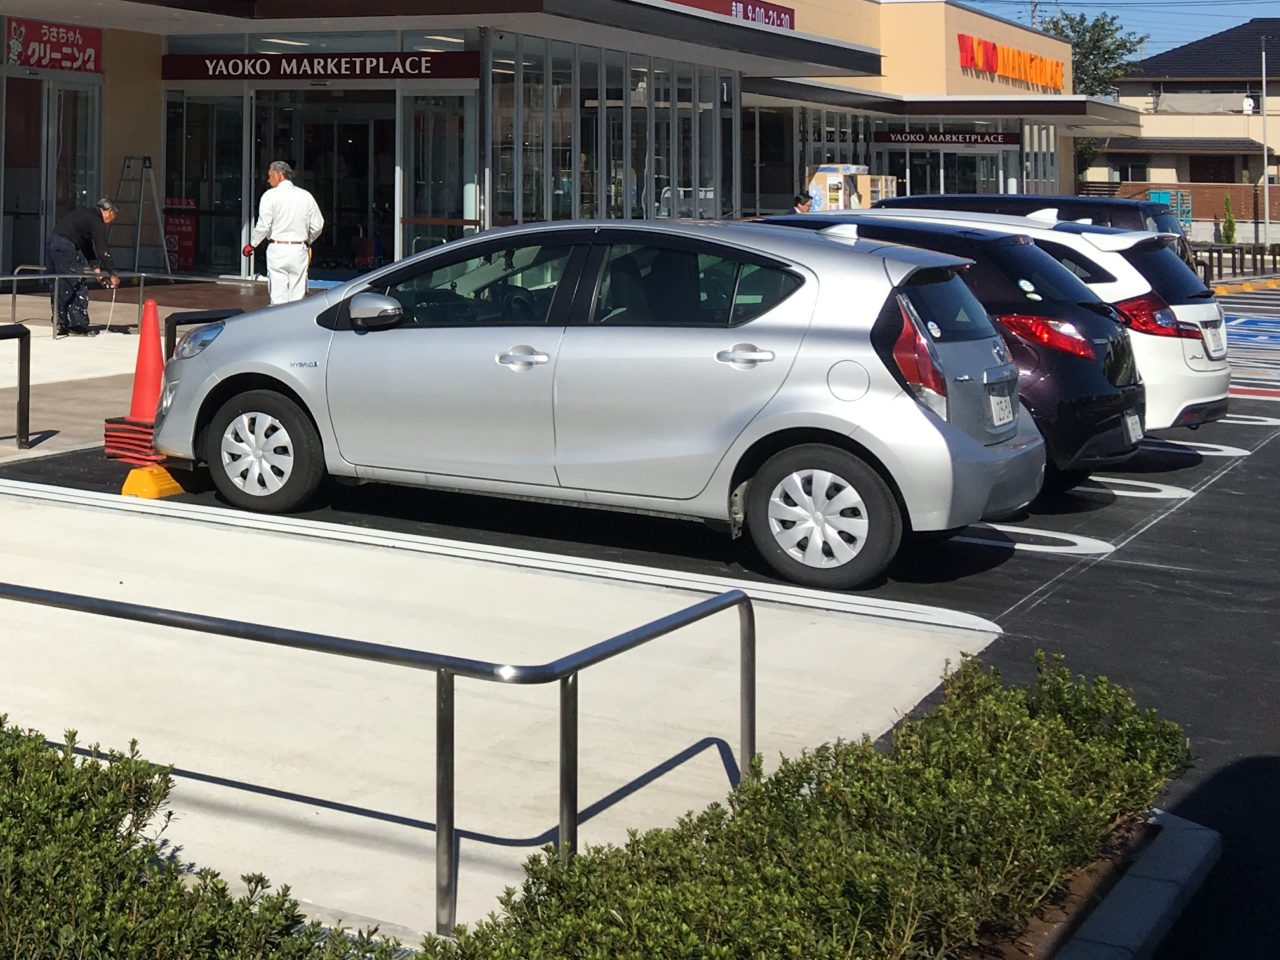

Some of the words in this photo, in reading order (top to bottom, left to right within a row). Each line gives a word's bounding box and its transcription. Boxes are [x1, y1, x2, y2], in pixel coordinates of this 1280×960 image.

[41, 25, 83, 44] うさちゃん
[205, 58, 270, 76] YAOKO
[280, 56, 431, 75] MARKETPLACE
[890, 133, 925, 142] YAOKO
[928, 134, 1004, 143] MARKETPLACE
